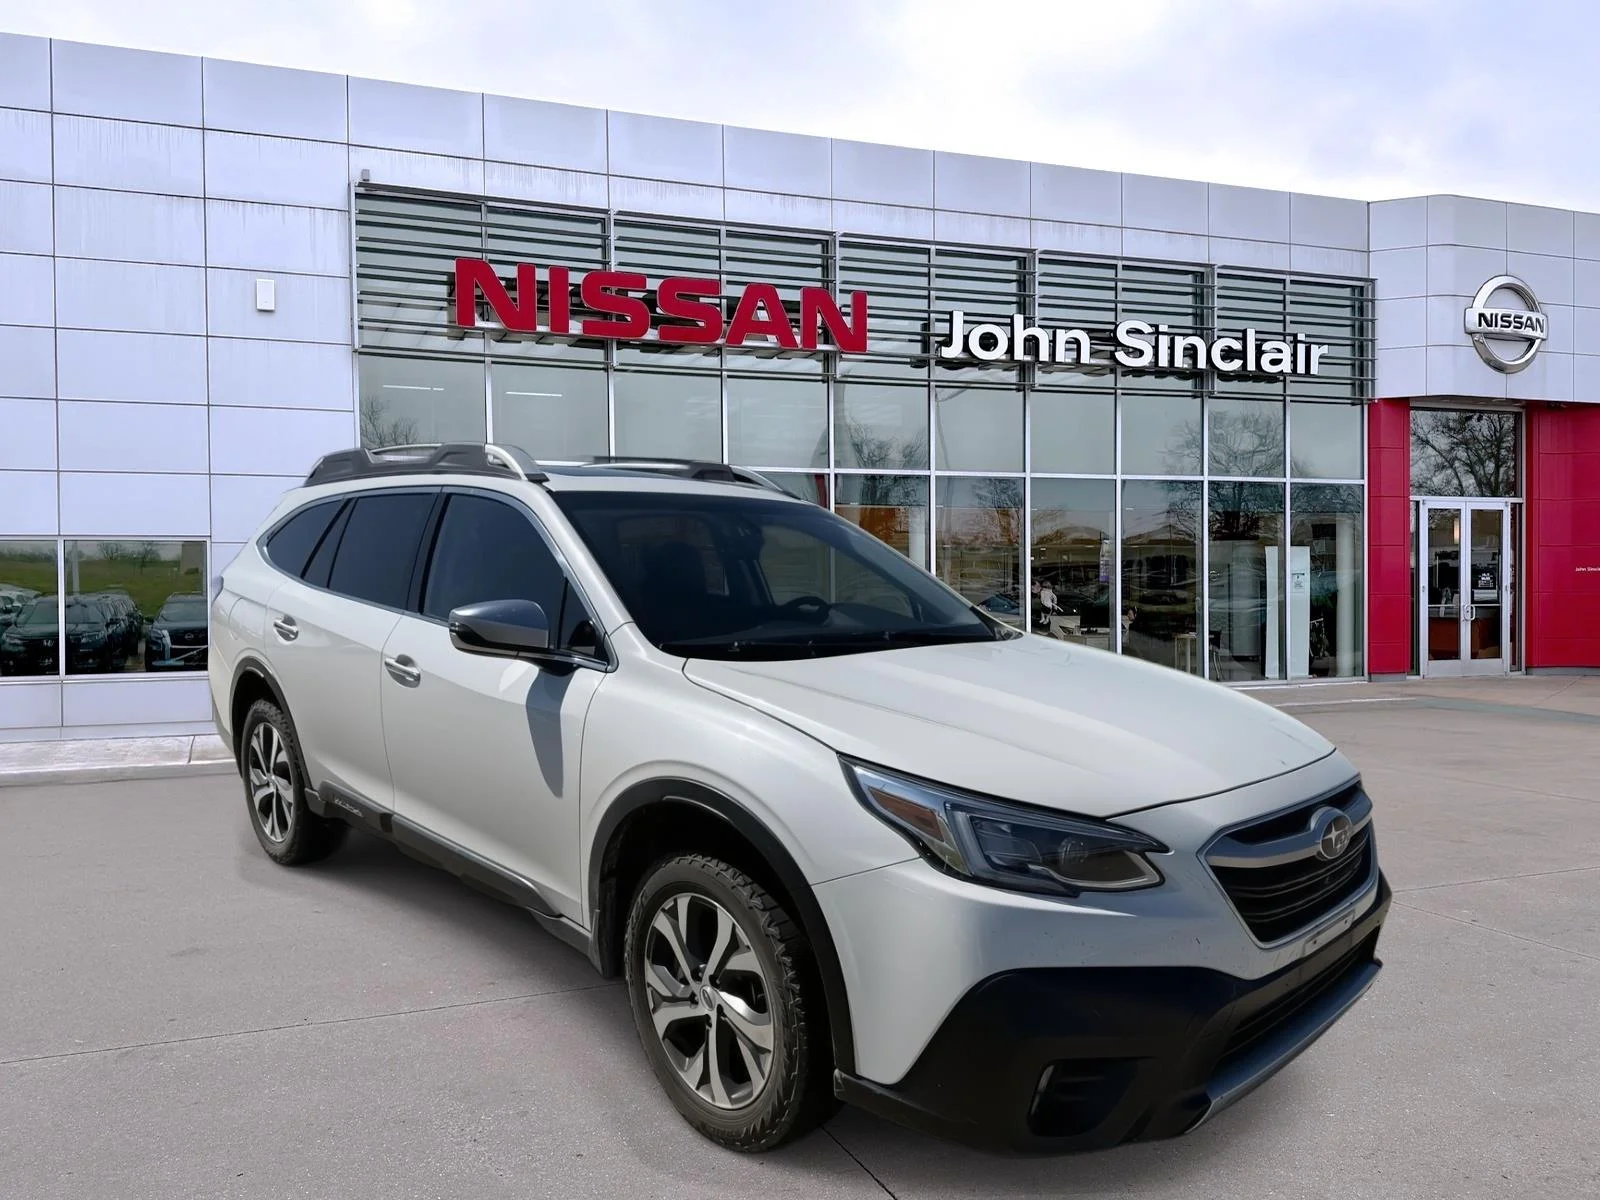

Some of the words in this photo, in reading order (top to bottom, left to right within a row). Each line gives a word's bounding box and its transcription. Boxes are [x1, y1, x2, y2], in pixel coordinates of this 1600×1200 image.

[455, 257, 868, 352] NISSAN
[1478, 312, 1544, 333] NISSAN
[941, 310, 1090, 364] John
[1114, 319, 1329, 374] Sinclair
